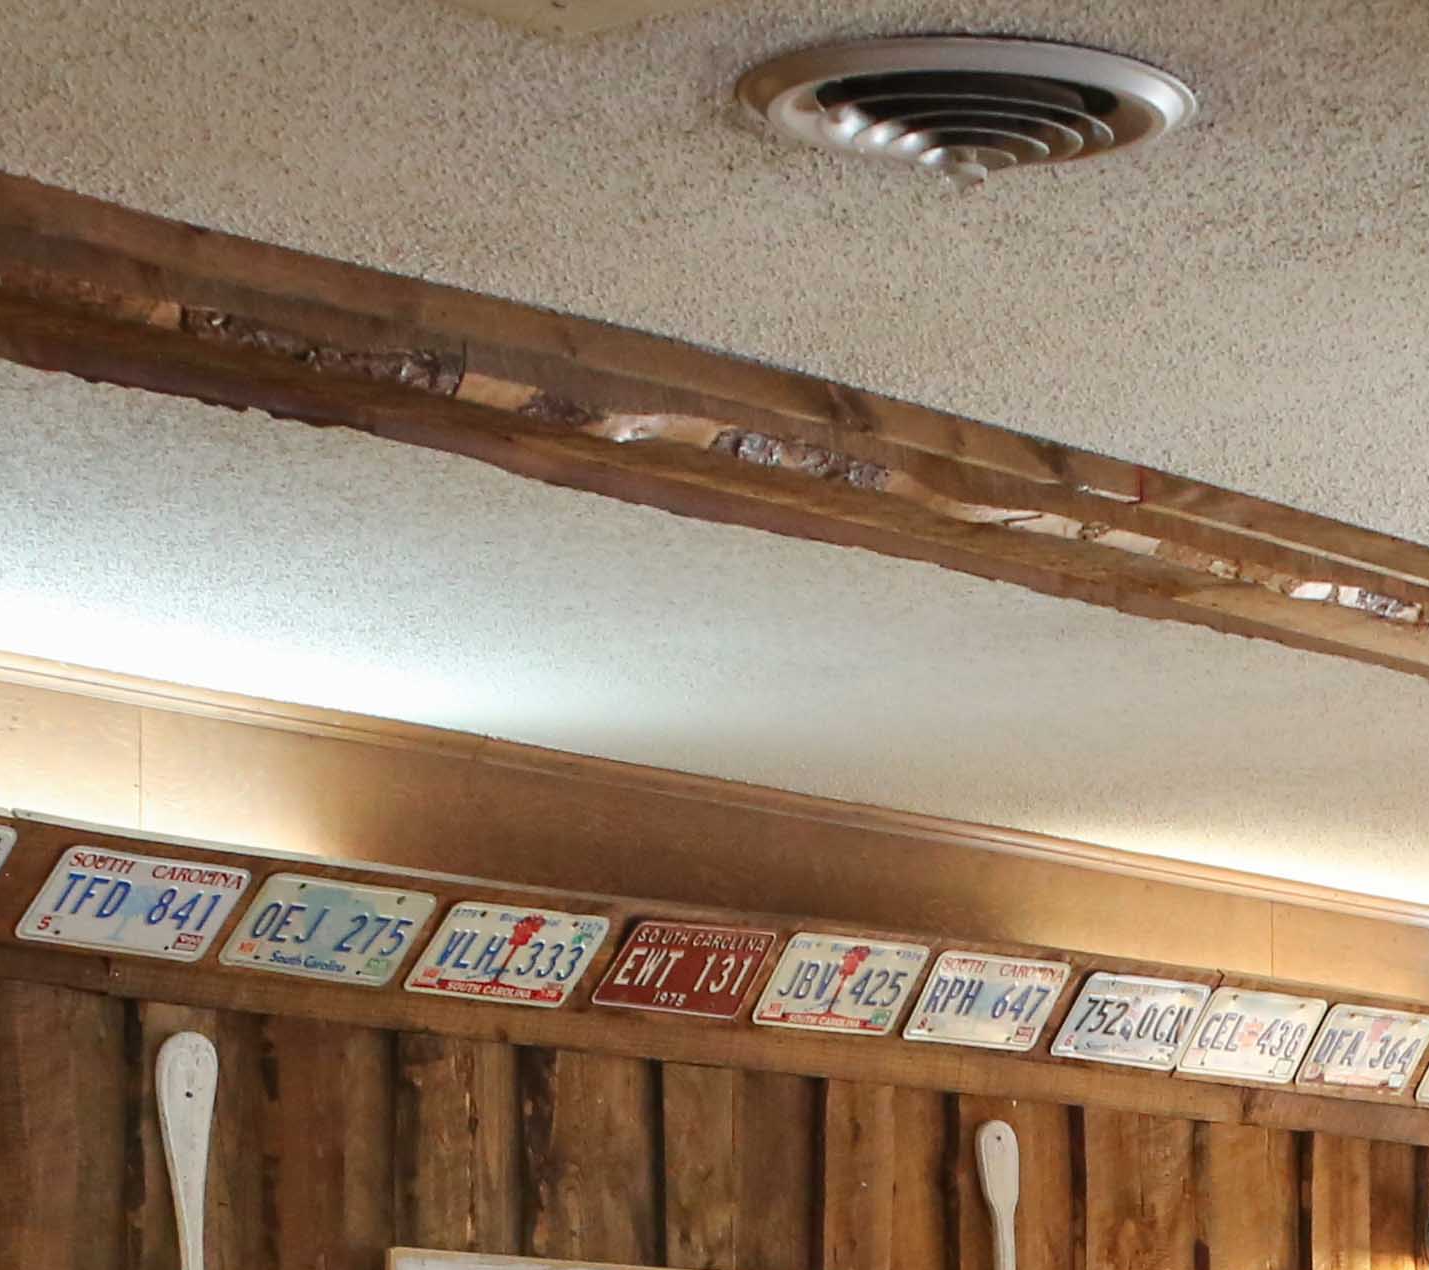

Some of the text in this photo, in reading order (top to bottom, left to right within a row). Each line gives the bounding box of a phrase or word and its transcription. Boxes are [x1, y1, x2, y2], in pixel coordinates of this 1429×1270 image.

[69, 852, 244, 890] SOUTH CAROLINA
[54, 873, 223, 931] TFD 841
[37, 916, 52, 930] 5
[333, 914, 413, 956] 275
[638, 928, 765, 952] SOUTH CAROLINA
[269, 950, 302, 965] South
[304, 955, 346, 972] Carolina
[437, 929, 585, 981] VLH 333
[614, 947, 754, 995] EWT 131
[942, 957, 1065, 983] SOUTH CAROLINA
[446, 980, 532, 998] SOUTH CAROLINA
[777, 961, 908, 1007] JBV 425
[924, 975, 1052, 1023] RPH 647
[1075, 997, 1130, 1035] 752
